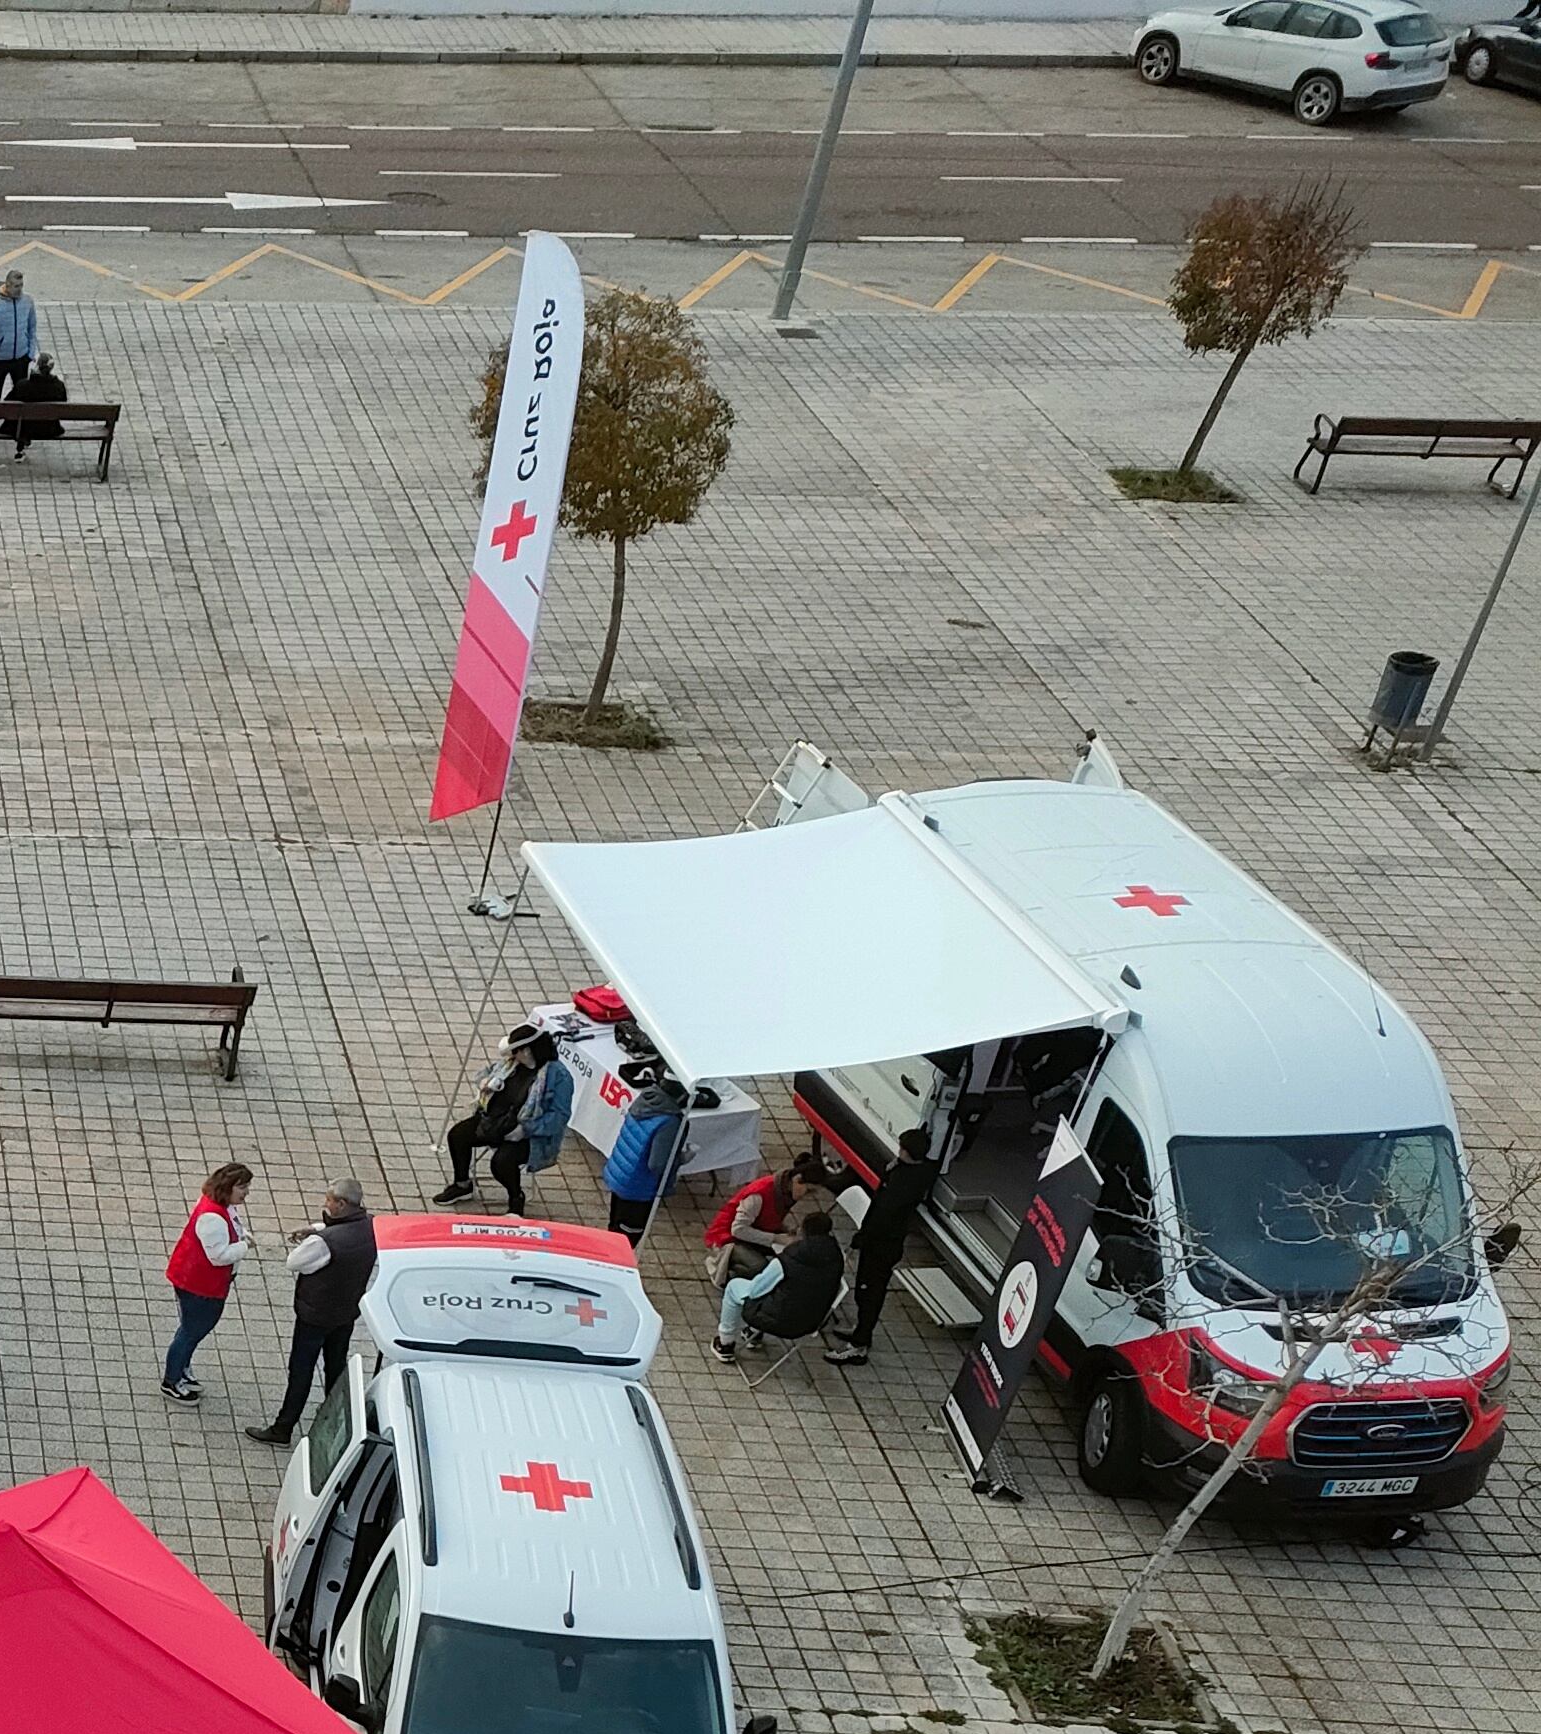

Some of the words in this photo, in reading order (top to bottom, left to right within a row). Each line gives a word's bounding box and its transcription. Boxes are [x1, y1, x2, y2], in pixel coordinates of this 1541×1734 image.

[421, 1292, 482, 1311] Roja
[490, 1299, 553, 1315] Cruz
[1335, 1482, 1376, 1494] 3244
[1380, 1479, 1413, 1492] MGC
